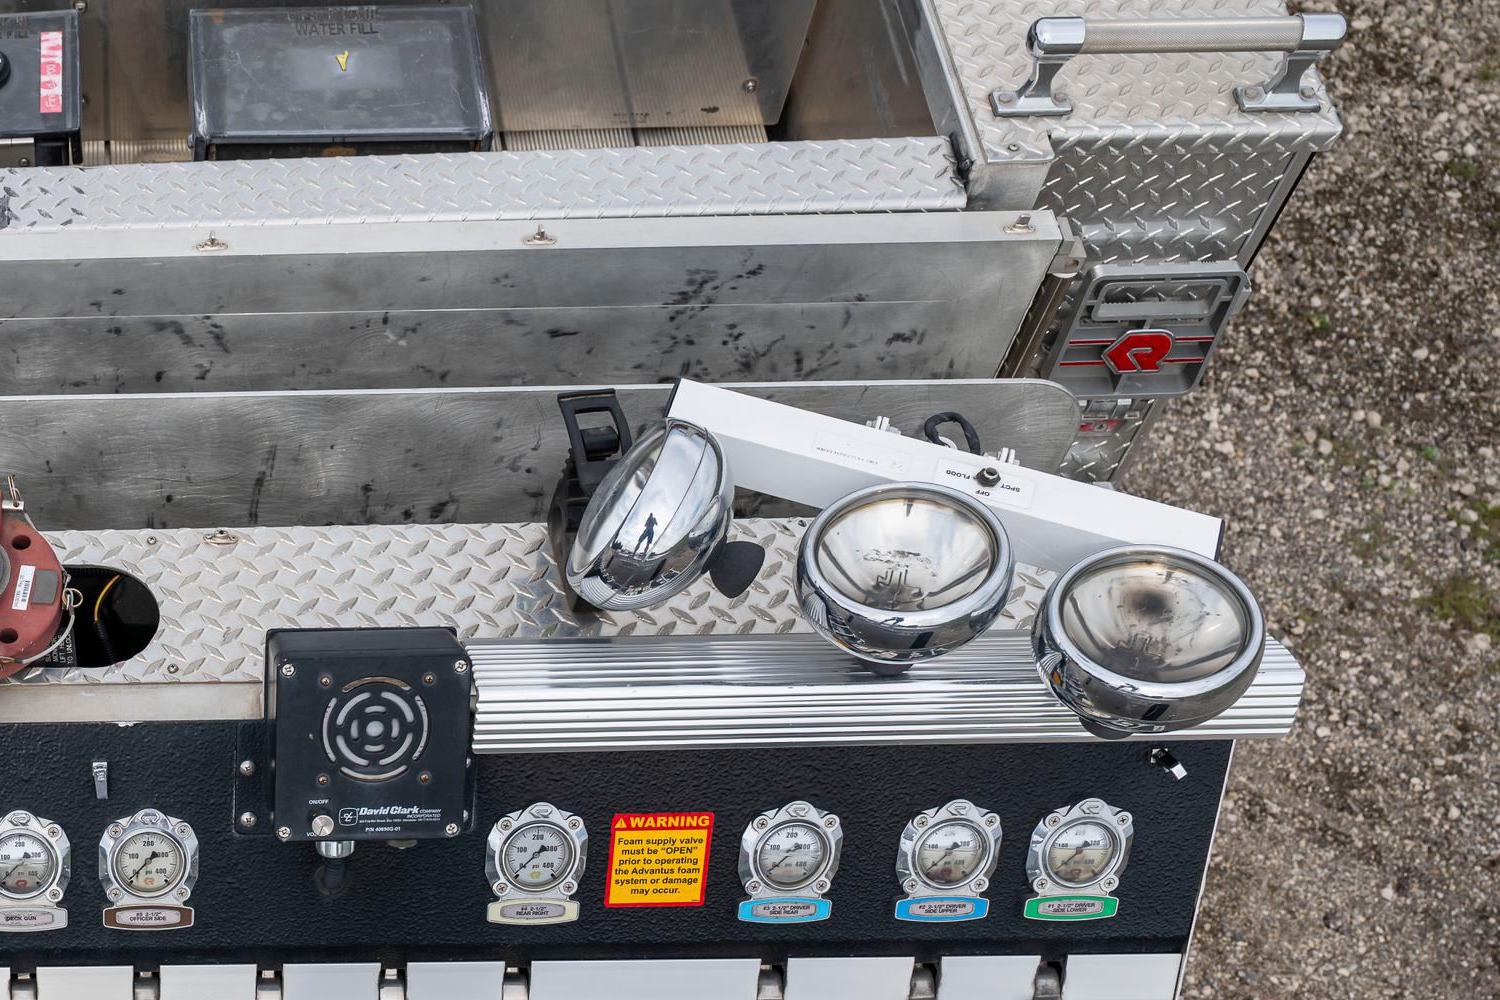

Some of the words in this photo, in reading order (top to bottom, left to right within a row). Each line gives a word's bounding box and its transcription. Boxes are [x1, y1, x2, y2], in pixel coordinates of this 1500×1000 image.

[295, 23, 346, 36] WATER
[350, 22, 379, 35] FILL
[946, 470, 971, 480] FLOOD
[1000, 483, 1020, 492] SPOT
[976, 489, 990, 497] OFF
[67, 657, 73, 665] TO
[359, 807, 389, 816] David
[390, 805, 419, 814] Clark
[630, 815, 710, 828] WARNING
[645, 837, 677, 846] supply
[647, 847, 658, 855] be
[619, 858, 641, 866] prior
[655, 857, 698, 866] operating
[615, 877, 648, 886] system
[662, 876, 698, 885] damage
[630, 888, 650, 896] may
